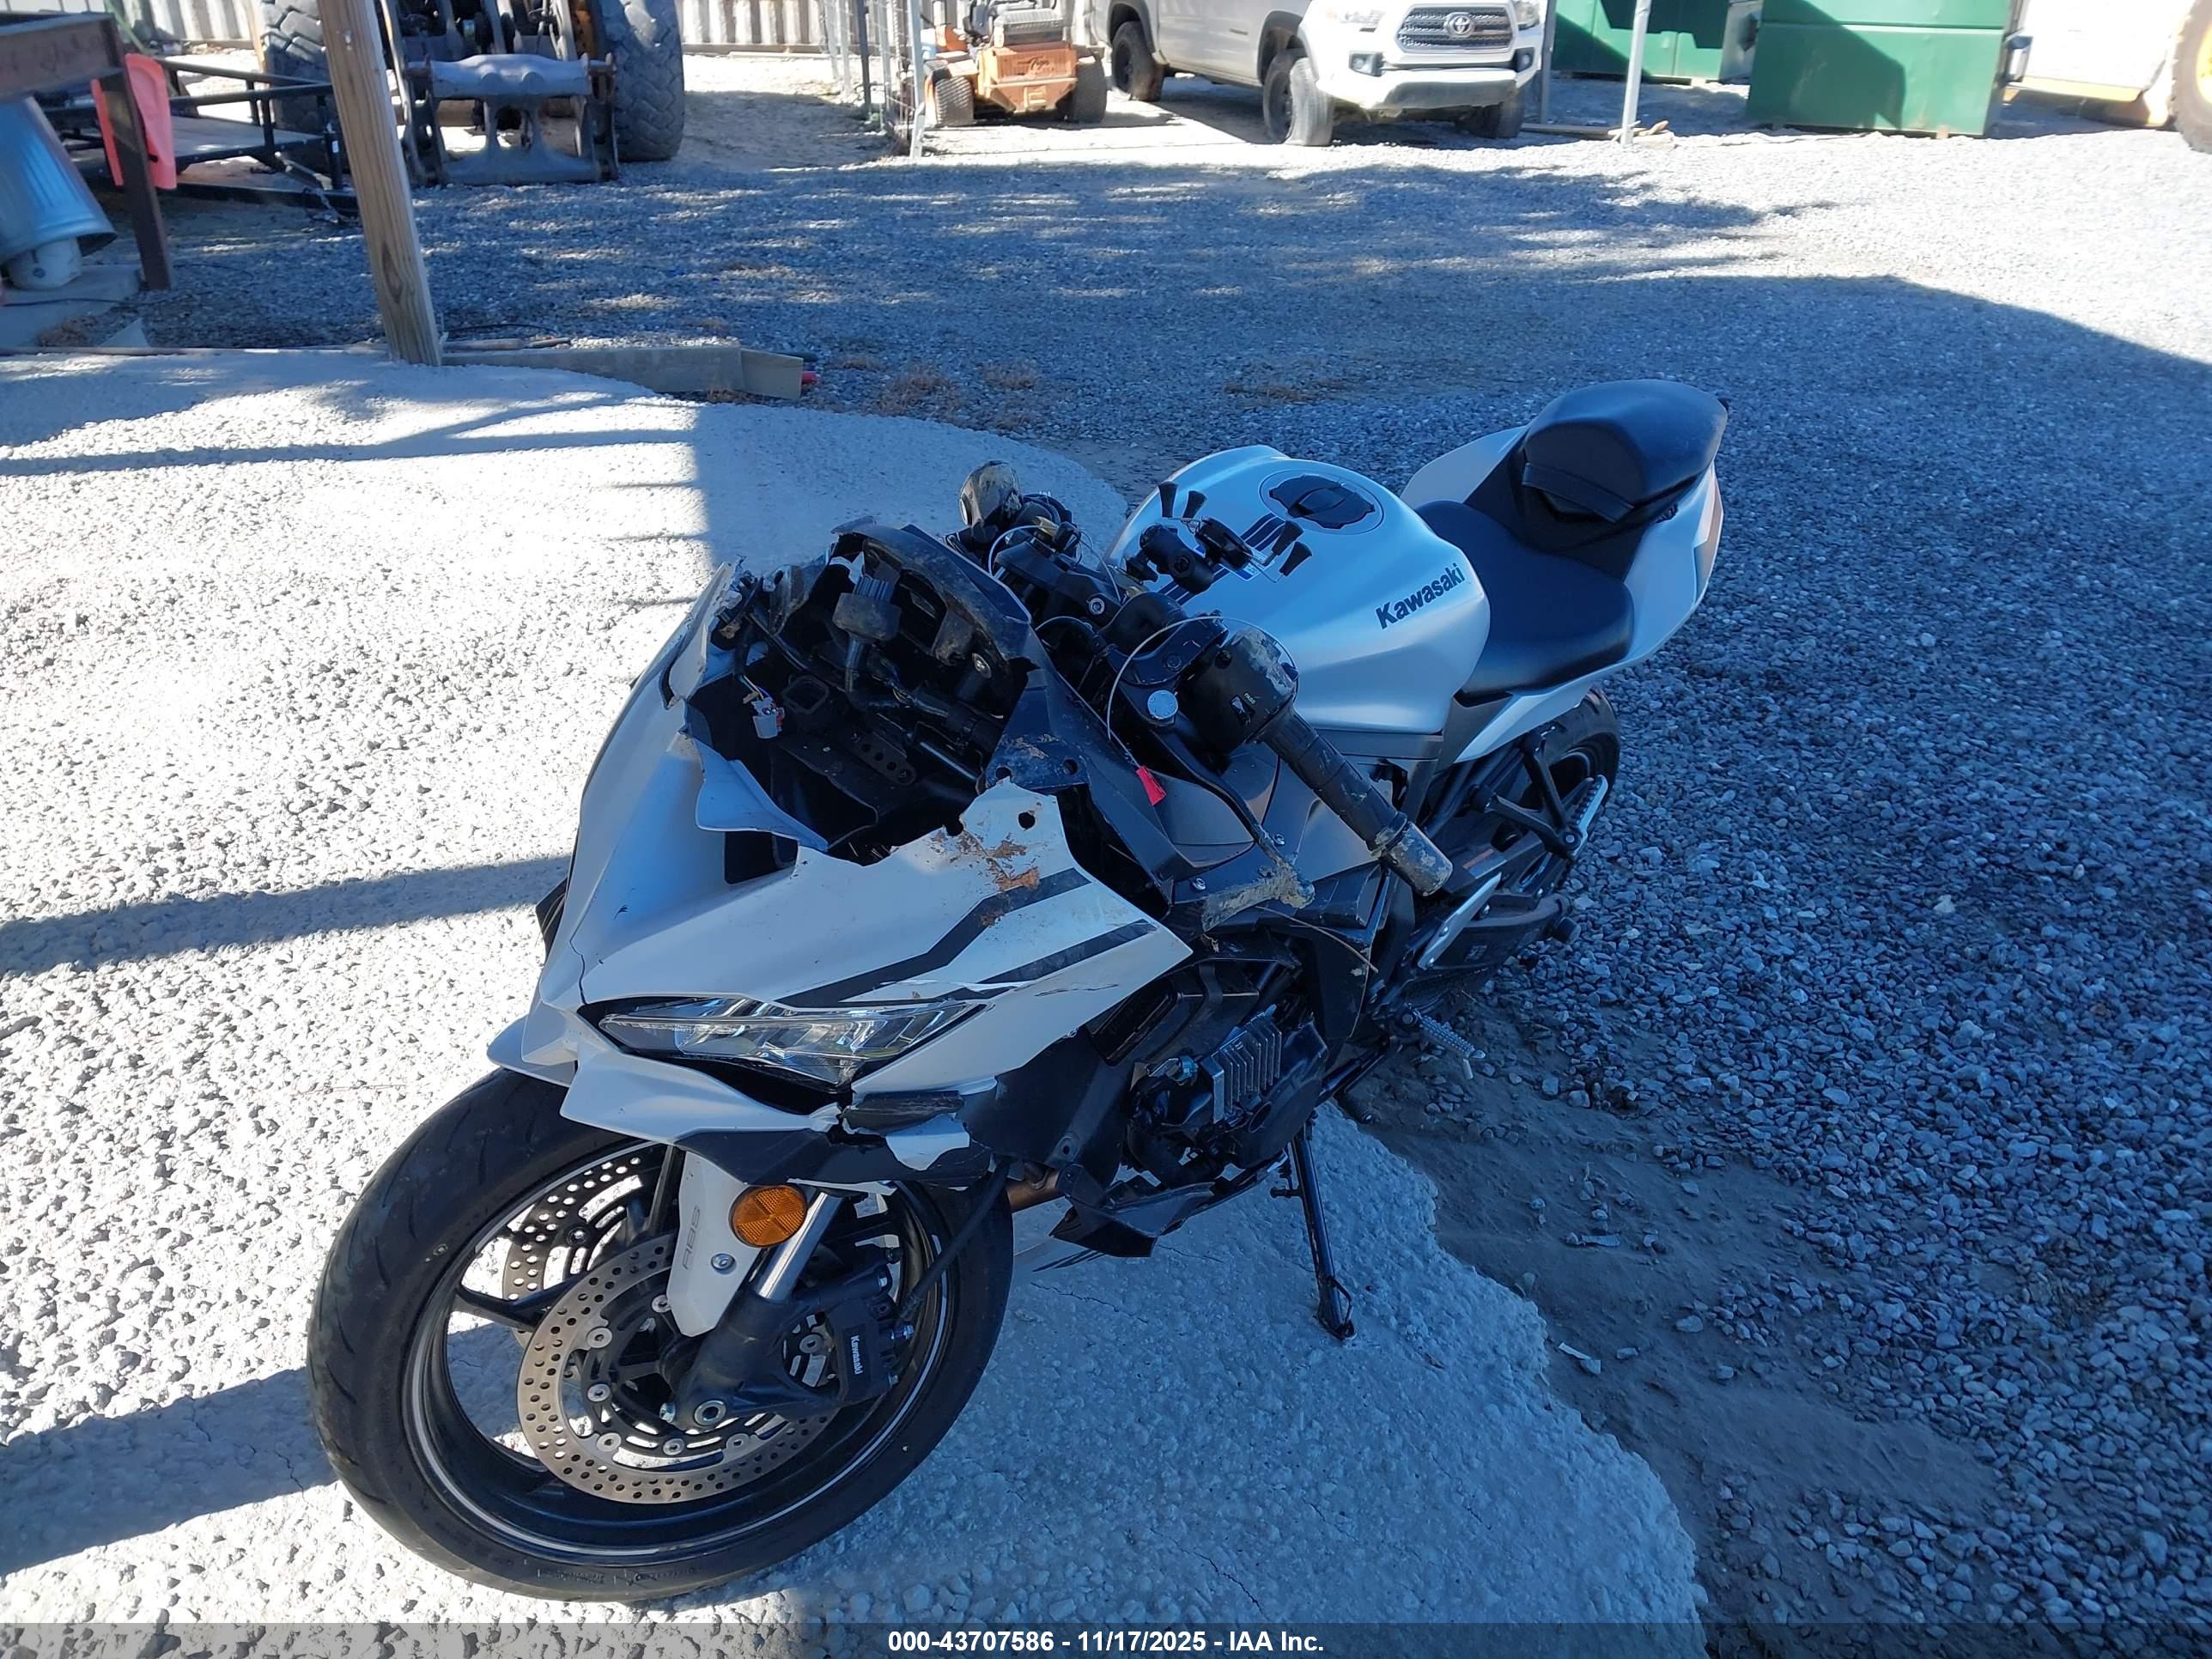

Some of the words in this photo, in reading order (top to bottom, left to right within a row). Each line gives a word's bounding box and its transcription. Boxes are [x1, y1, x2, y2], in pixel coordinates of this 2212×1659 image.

[1376, 562, 1465, 629] Kawasaki
[683, 1206, 700, 1270] ABS
[851, 1335, 863, 1374] Kawasaki
